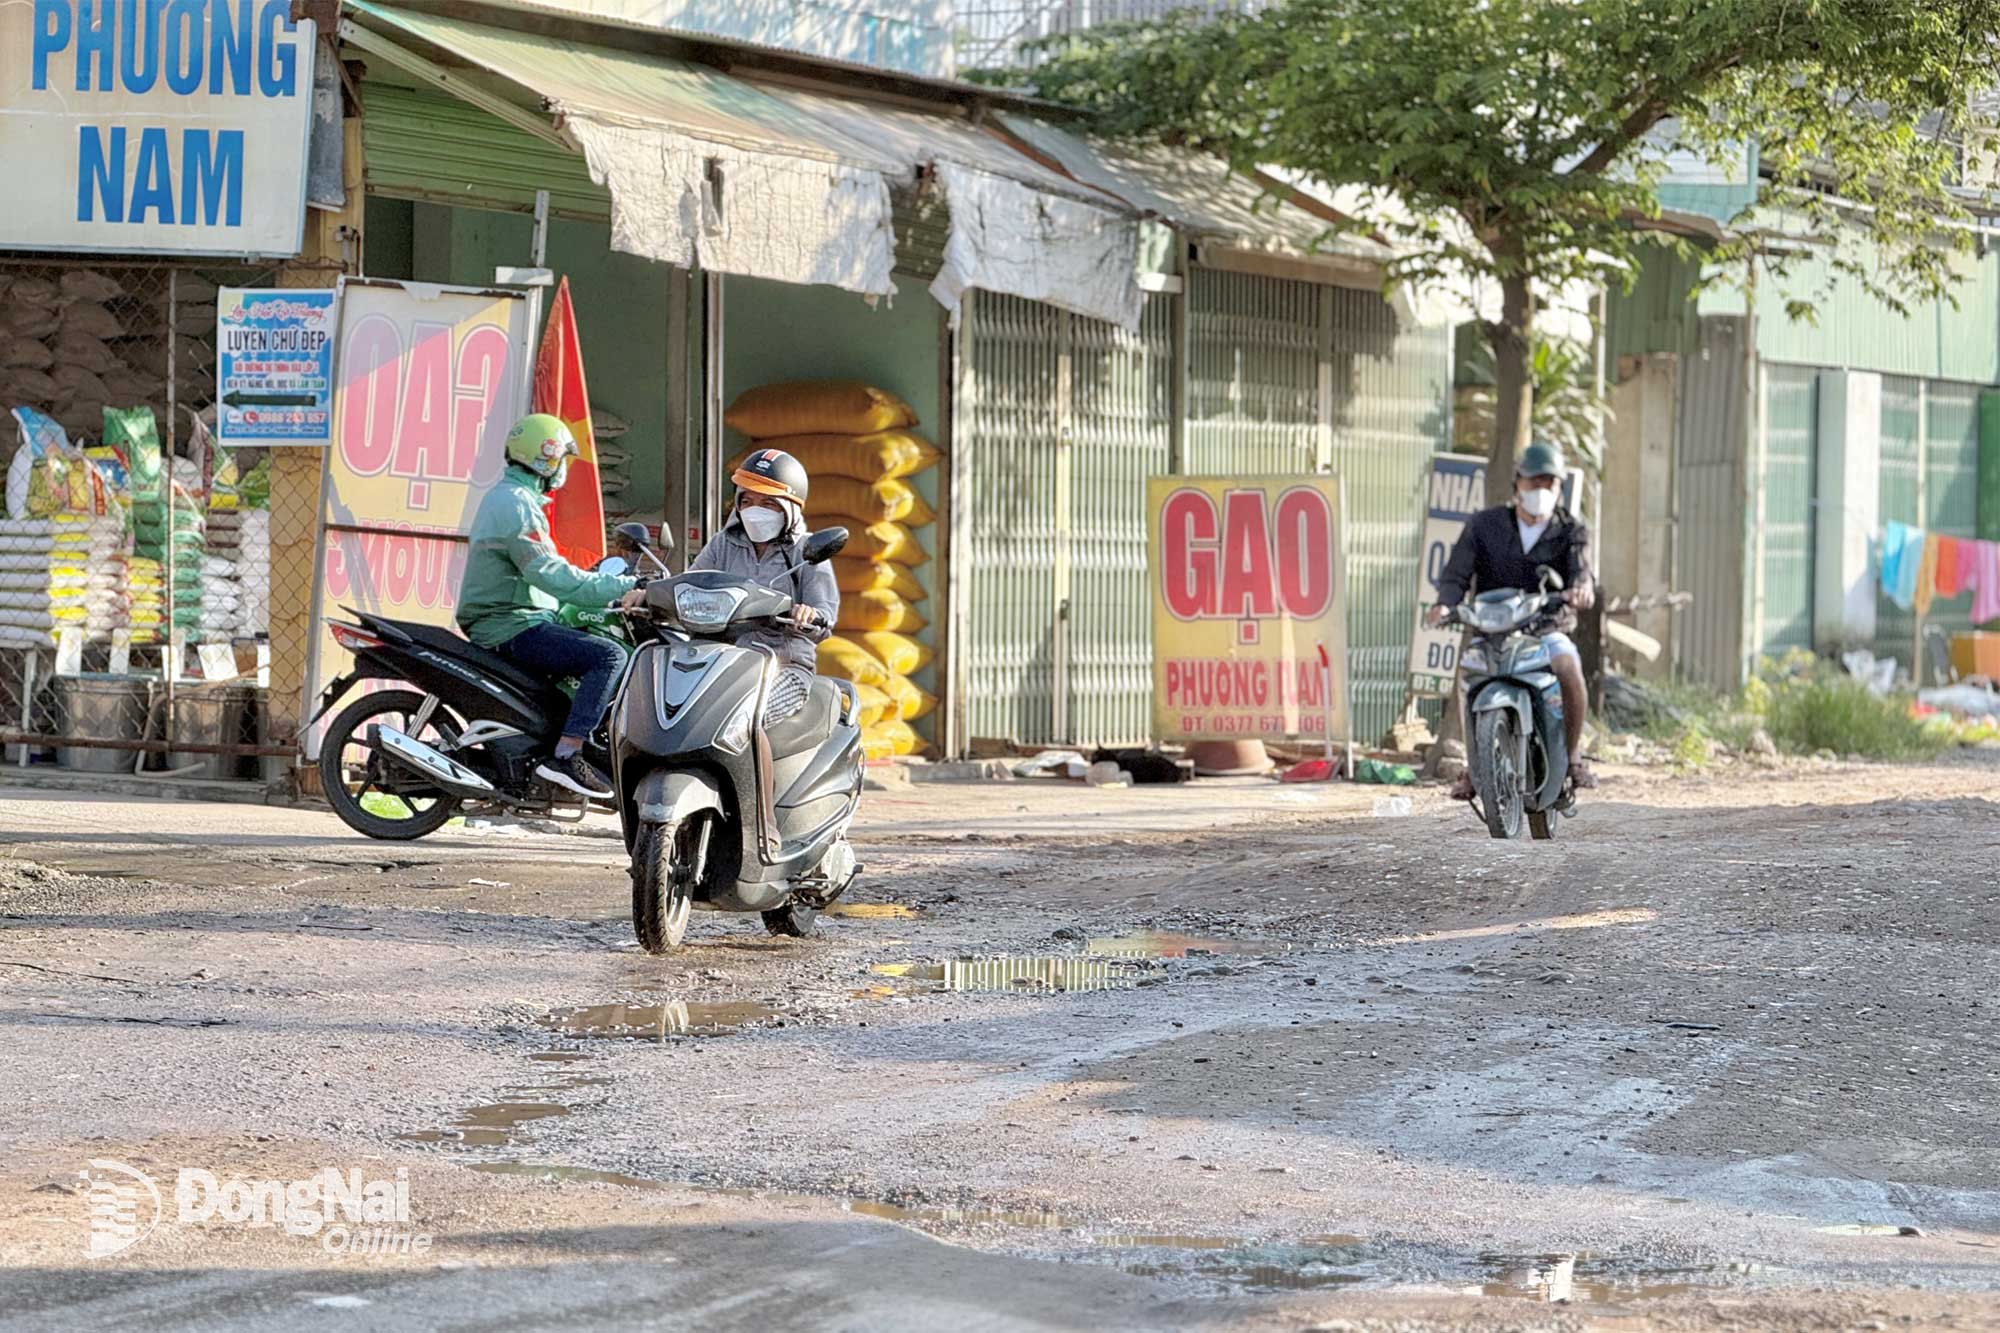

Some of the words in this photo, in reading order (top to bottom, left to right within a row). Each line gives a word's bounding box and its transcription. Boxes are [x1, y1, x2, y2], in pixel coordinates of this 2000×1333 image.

[77, 125, 244, 226] NAM
[1161, 485, 1335, 645] GẠO
[577, 611, 605, 624] Grab
